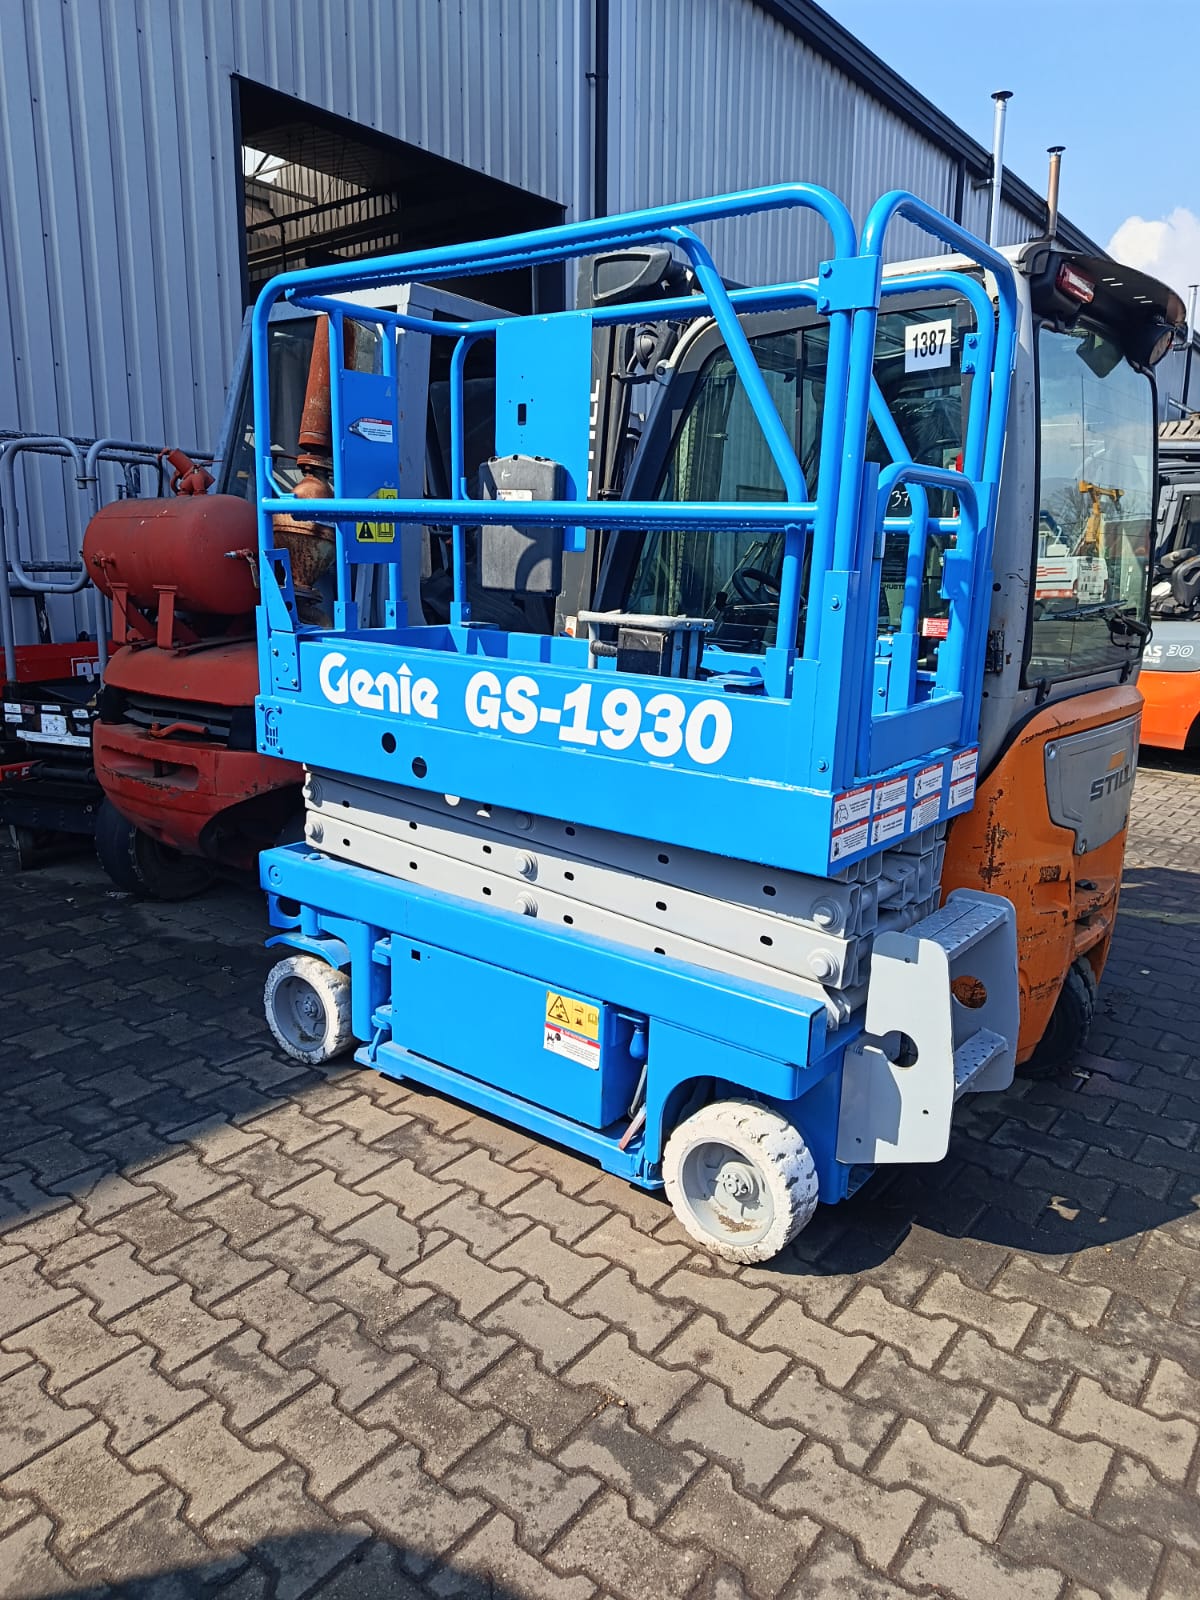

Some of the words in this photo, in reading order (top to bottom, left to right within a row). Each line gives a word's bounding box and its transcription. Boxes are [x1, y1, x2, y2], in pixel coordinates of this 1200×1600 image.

[912, 329, 946, 359] 1387
[1166, 644, 1194, 658] 30
[319, 652, 439, 720] Genie
[465, 671, 733, 765] GS-1930
[1089, 764, 1131, 802] STILL
